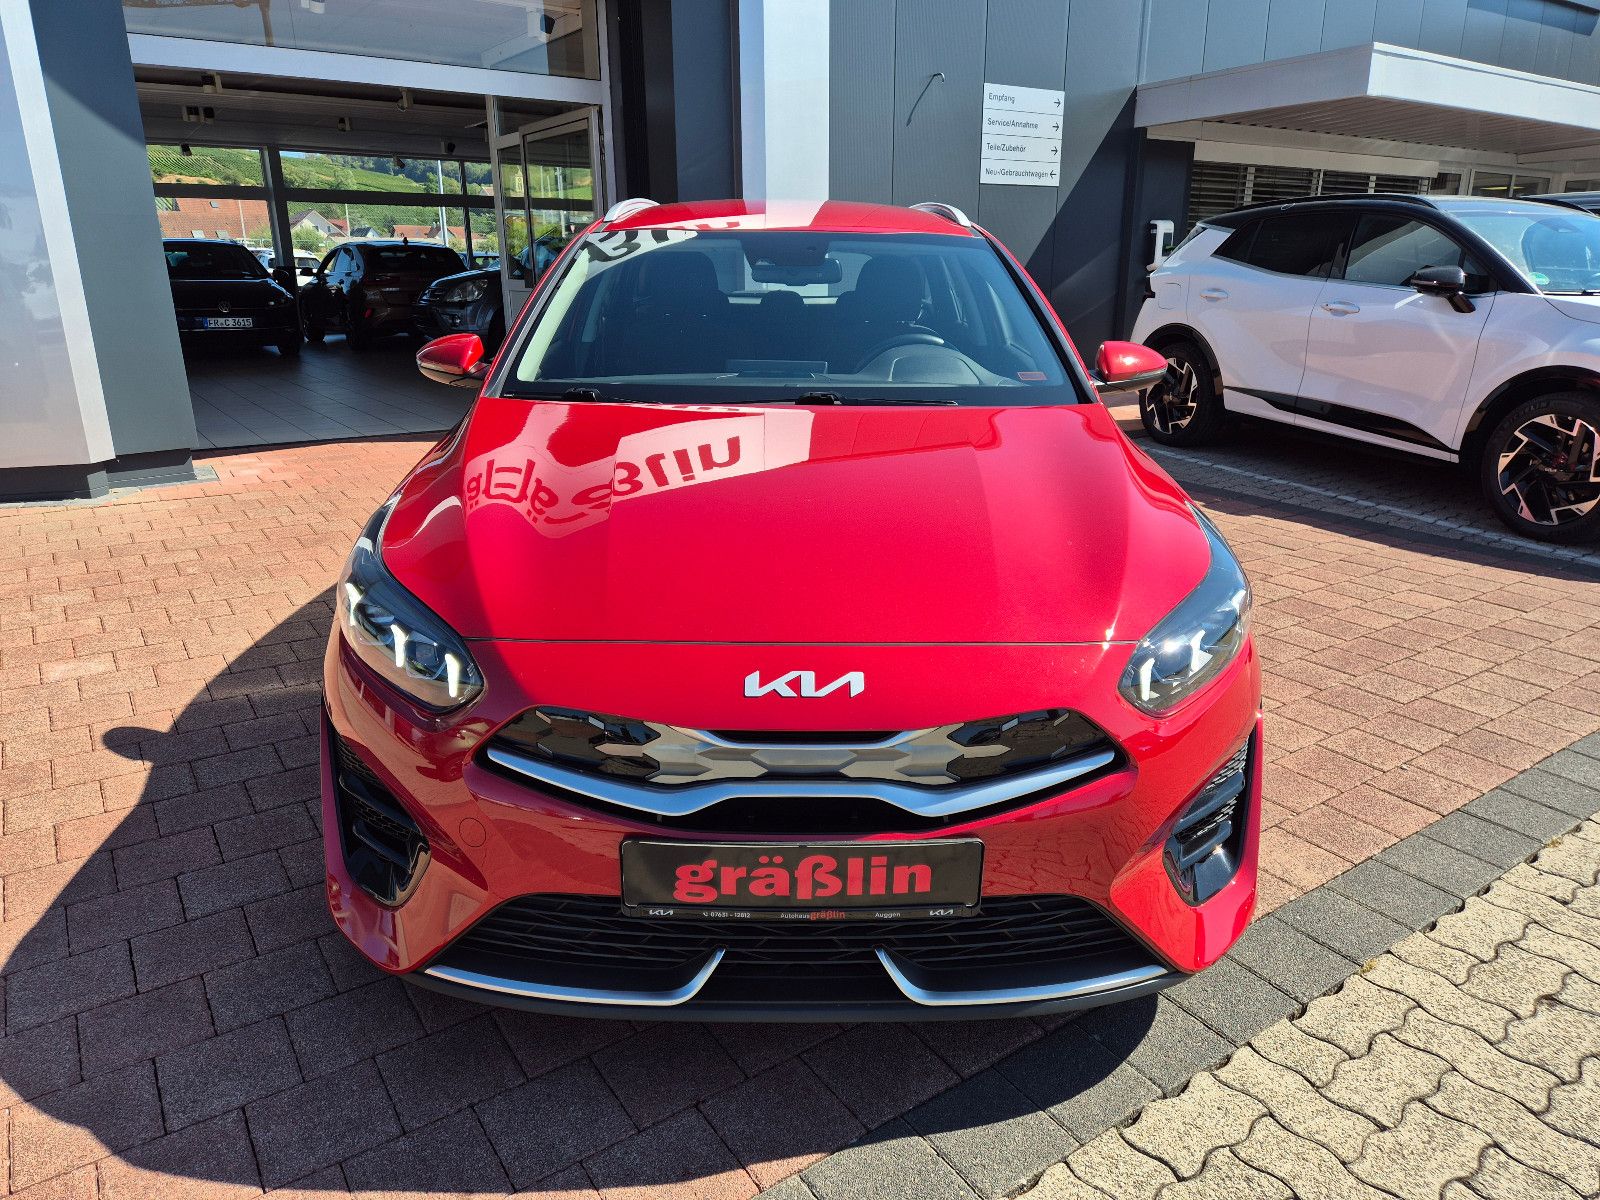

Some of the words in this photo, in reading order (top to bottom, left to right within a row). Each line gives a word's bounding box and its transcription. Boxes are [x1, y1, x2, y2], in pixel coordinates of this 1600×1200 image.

[989, 93, 1015, 104] Empfang
[988, 118, 1039, 130] Service/Annahme
[986, 142, 1026, 153] Teile/Zubehör
[985, 168, 1049, 179] Neu-/Gebrauchtwagen
[232, 318, 252, 327] 3615
[744, 670, 865, 698] KIA
[672, 854, 933, 903] gräßlin
[875, 912, 901, 920] Auggen
